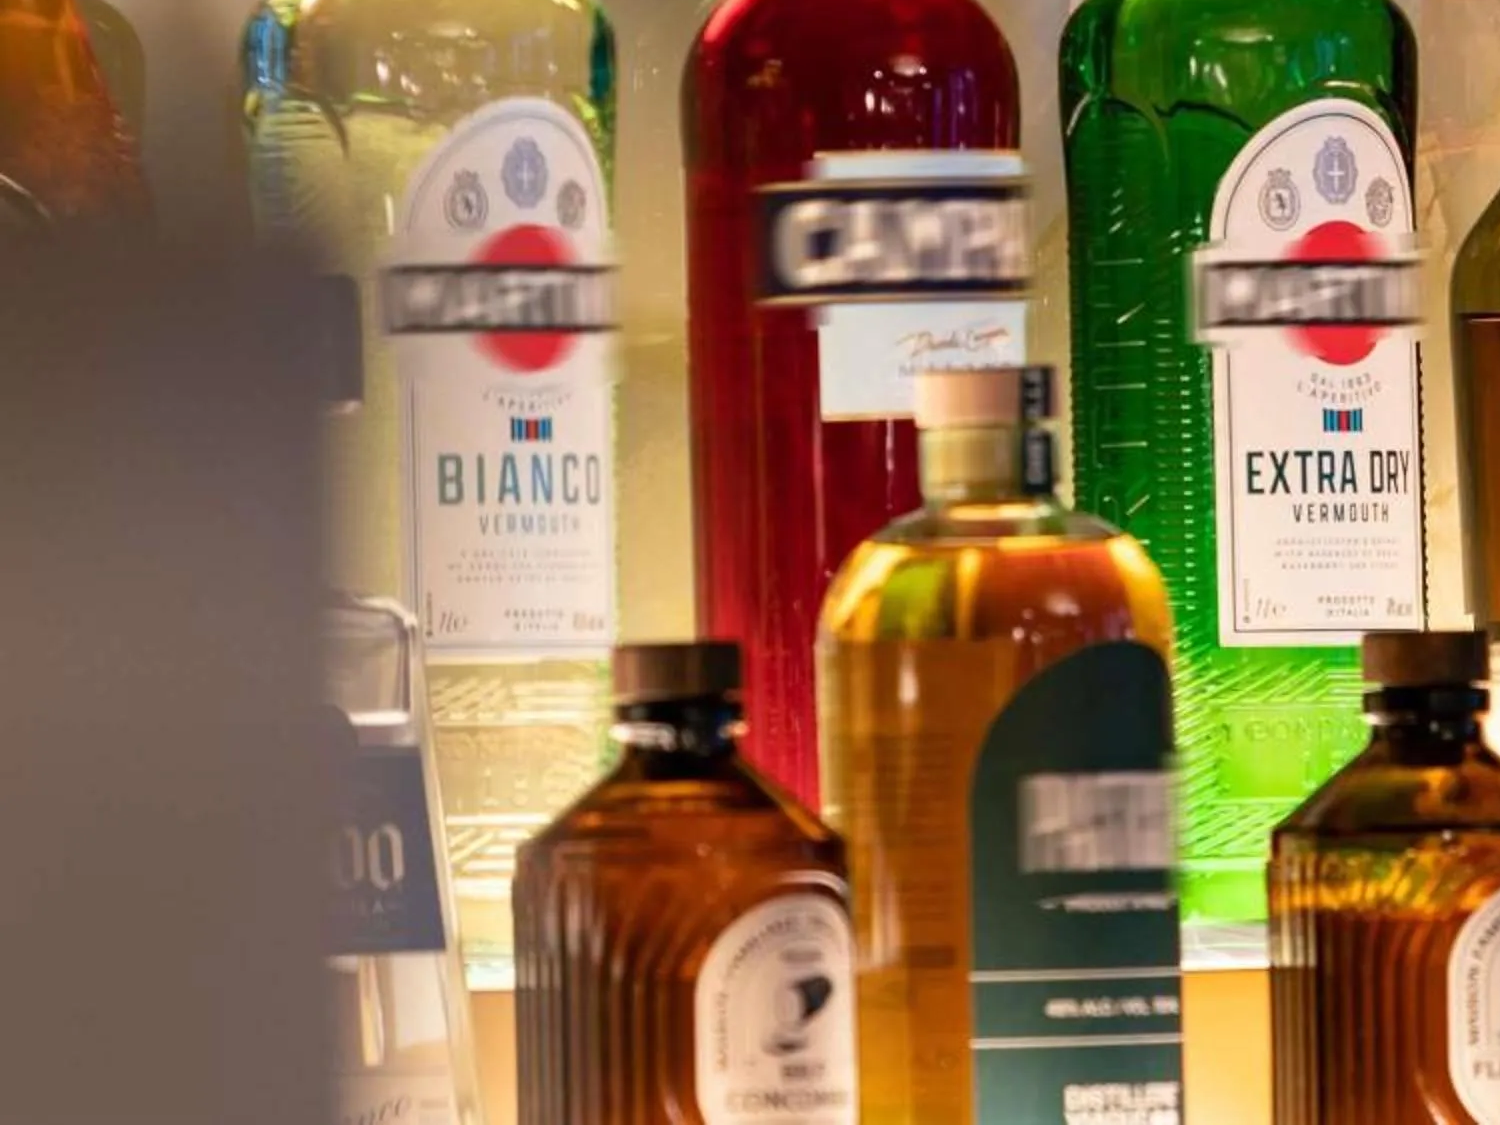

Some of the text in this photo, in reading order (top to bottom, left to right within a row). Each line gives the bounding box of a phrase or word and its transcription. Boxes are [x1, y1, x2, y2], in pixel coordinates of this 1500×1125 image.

[437, 452, 600, 506] BIANCO
[1246, 450, 1411, 495] EXTRA DRY
[1292, 503, 1389, 523] VERMOUTH
